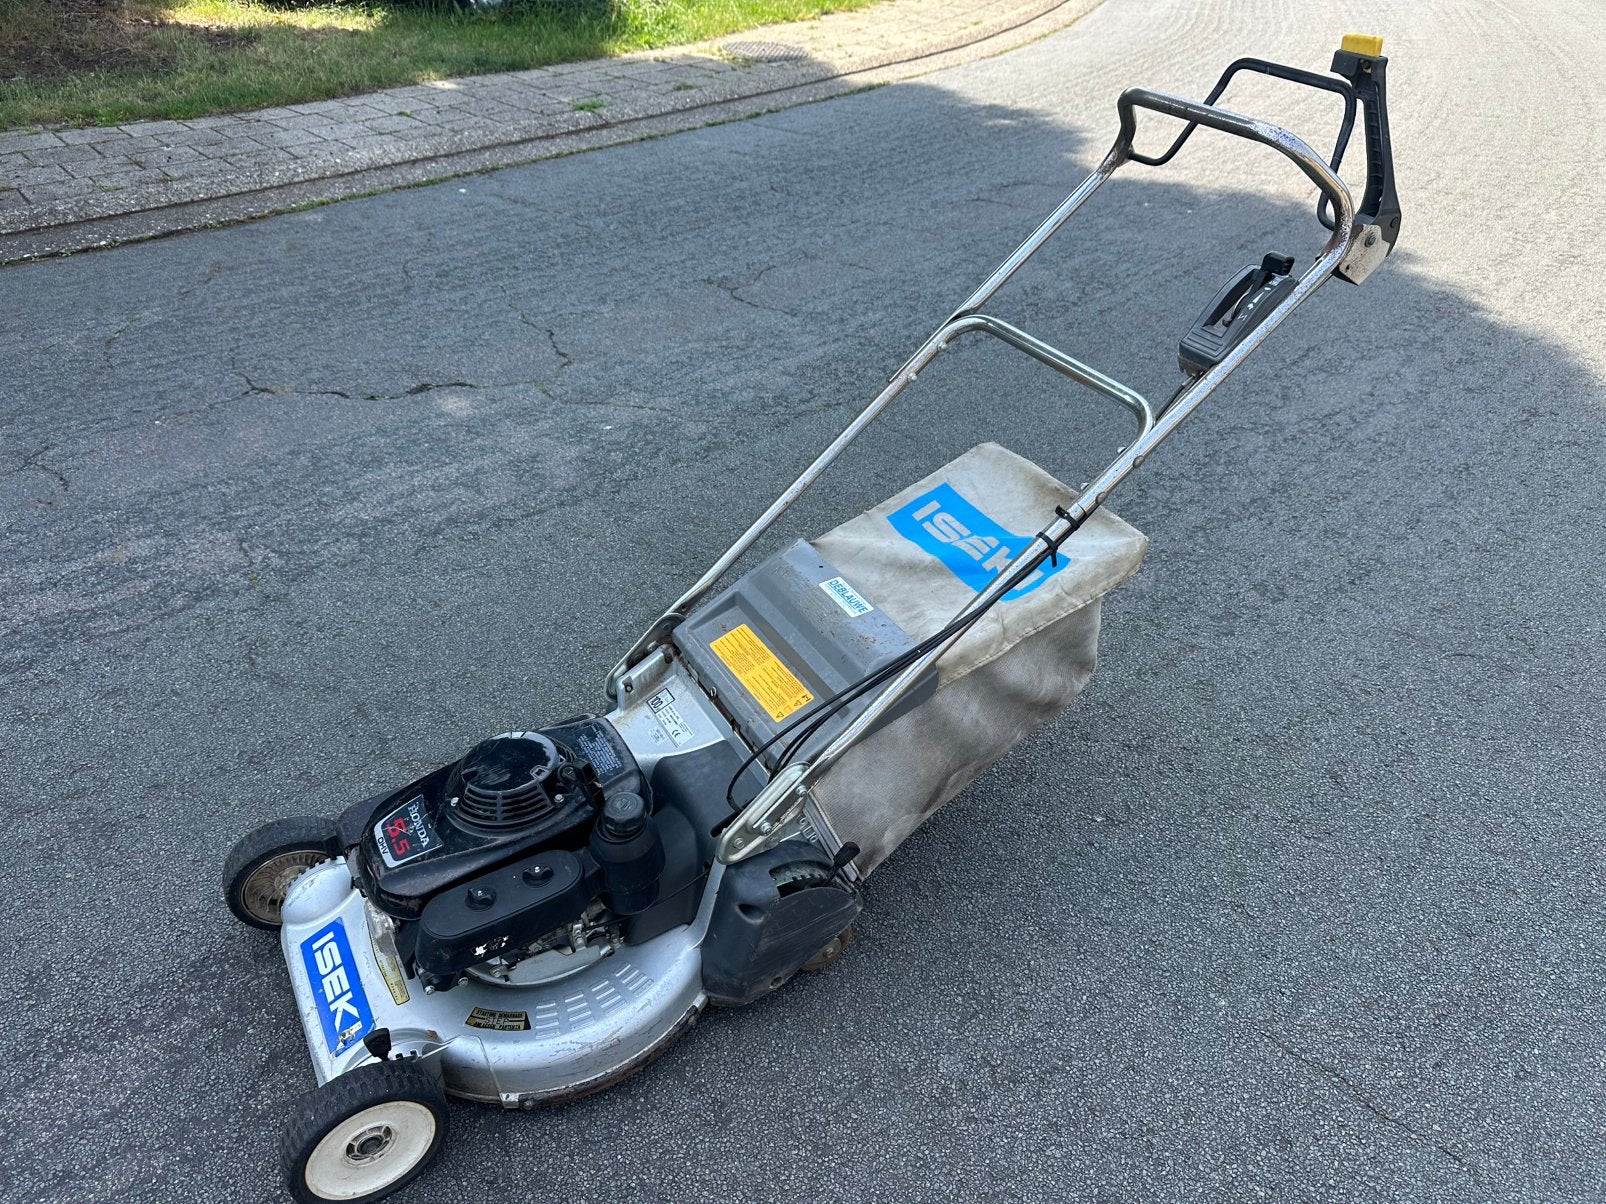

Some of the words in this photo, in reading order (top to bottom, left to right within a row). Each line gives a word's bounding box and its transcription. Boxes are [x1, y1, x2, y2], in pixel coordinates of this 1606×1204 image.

[829, 579, 868, 613] DEBLAUWE
[385, 818, 410, 855] 5.5
[407, 804, 429, 847] HONDA
[377, 836, 388, 854] OHV
